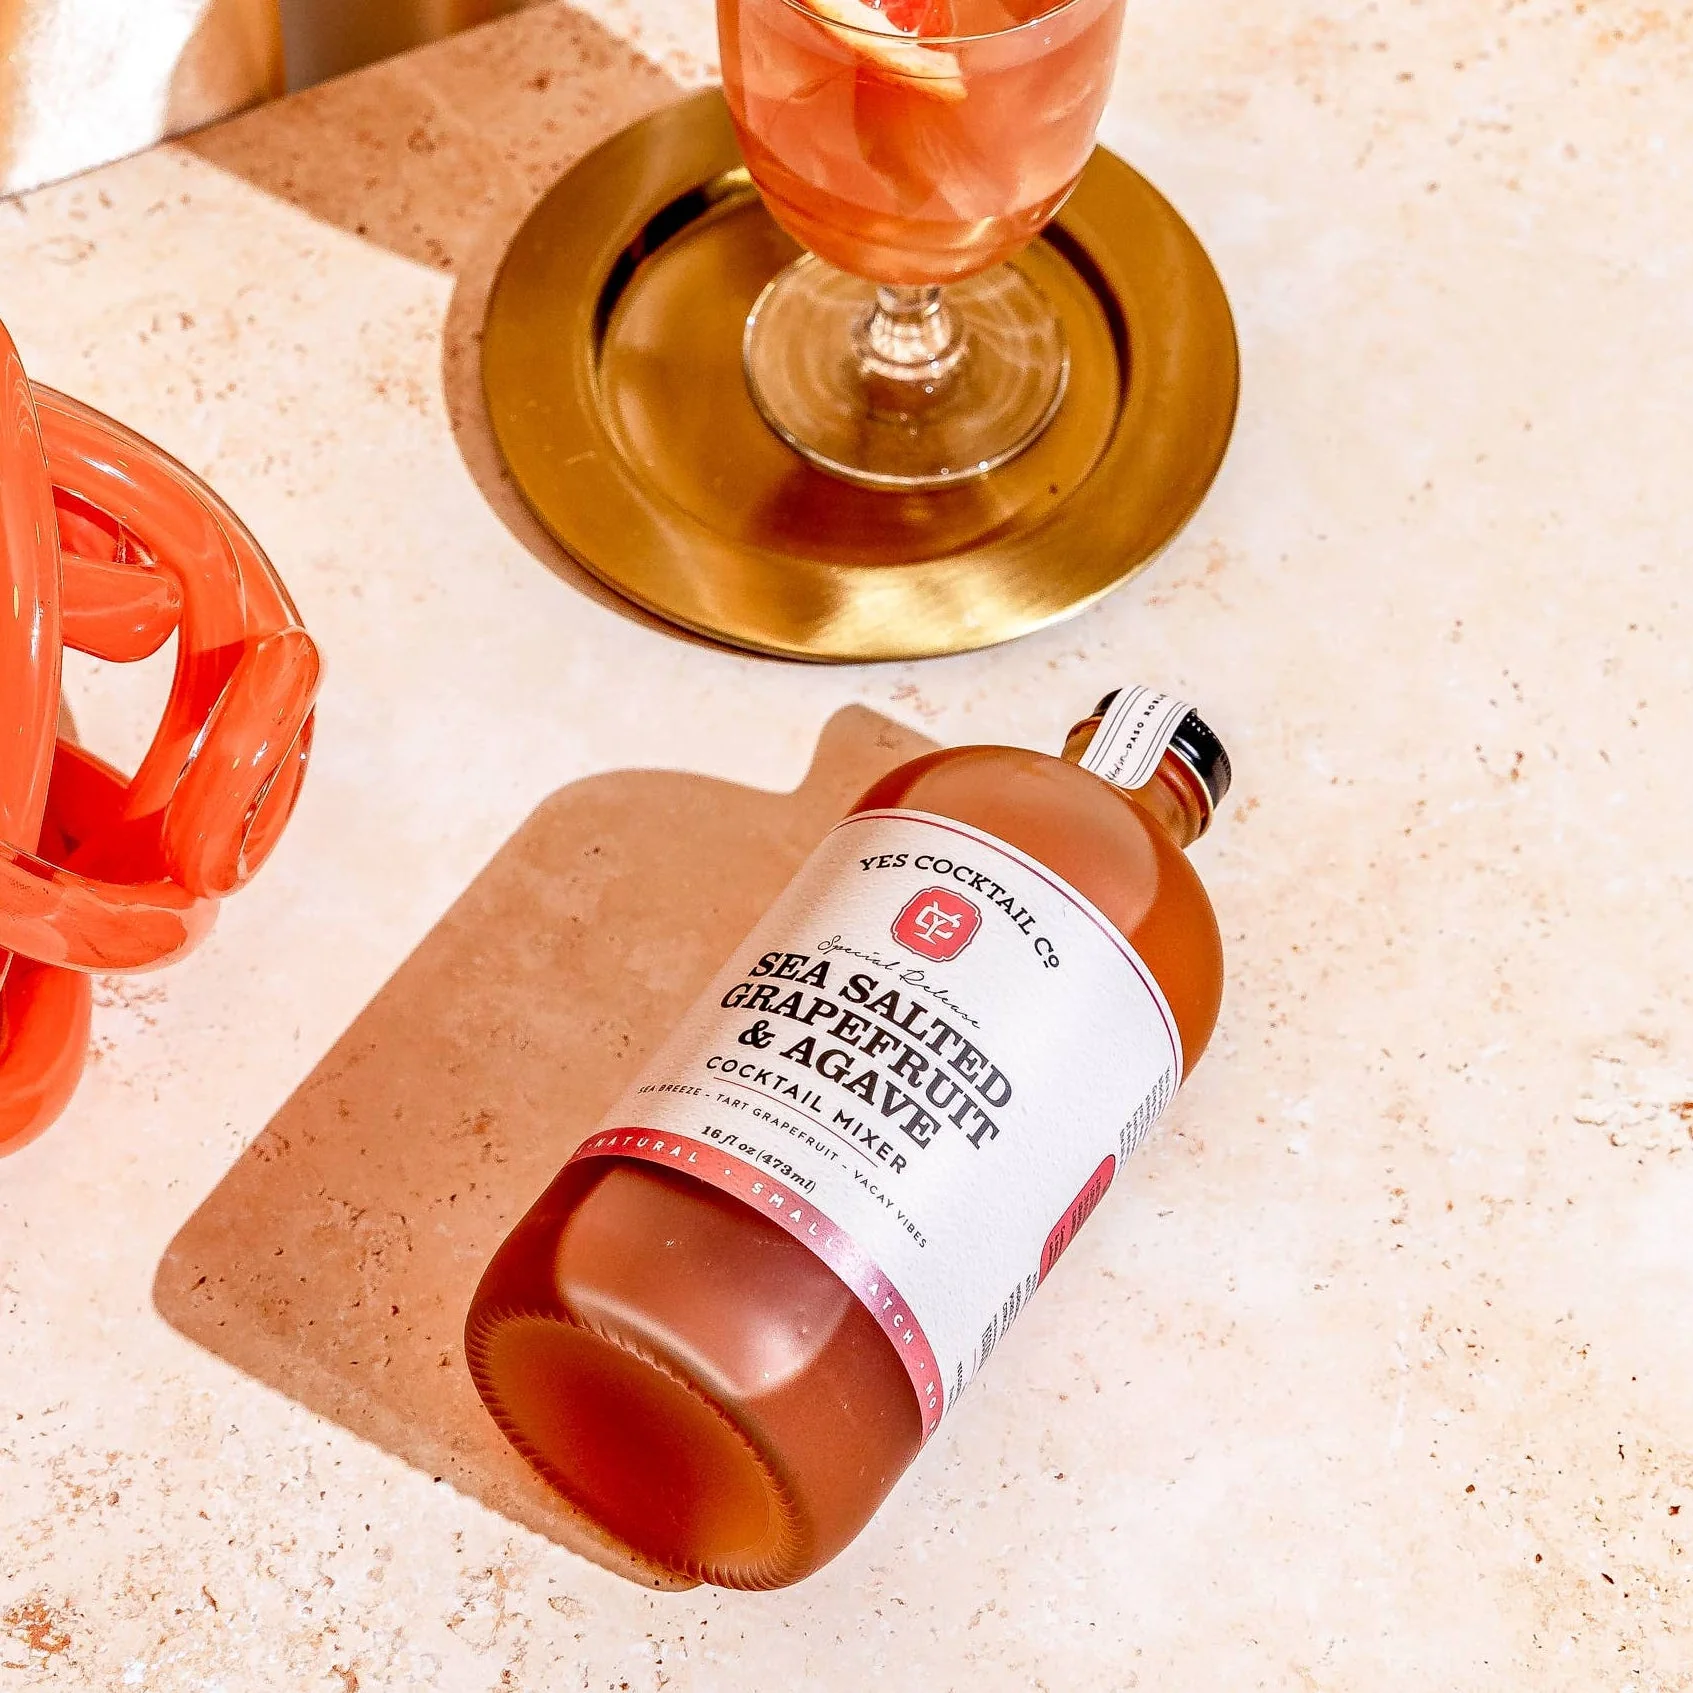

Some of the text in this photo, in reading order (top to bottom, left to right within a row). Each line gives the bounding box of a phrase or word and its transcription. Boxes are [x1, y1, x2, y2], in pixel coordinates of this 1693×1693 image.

[1126, 722, 1144, 749] PASO
[859, 853, 909, 871] YES
[914, 855, 1036, 936] COCKTAIL
[748, 951, 1013, 1109] SEA SALTED
[817, 935, 981, 1029] Special Release
[706, 1056, 907, 1175] COCKTAIL MIXER
[720, 983, 1000, 1151] GRAPEFRUIT
[738, 1019, 942, 1150] & AGAVE
[658, 1084, 702, 1096] BREEZE
[716, 1093, 749, 1110] TART
[753, 1108, 839, 1162] GRAPEFRUIT
[853, 1169, 894, 1209] VACAY
[897, 1209, 927, 1249] VIBES
[701, 1126, 817, 1194] 16 fl oz (473ml)
[867, 1281, 914, 1345] ATCH
